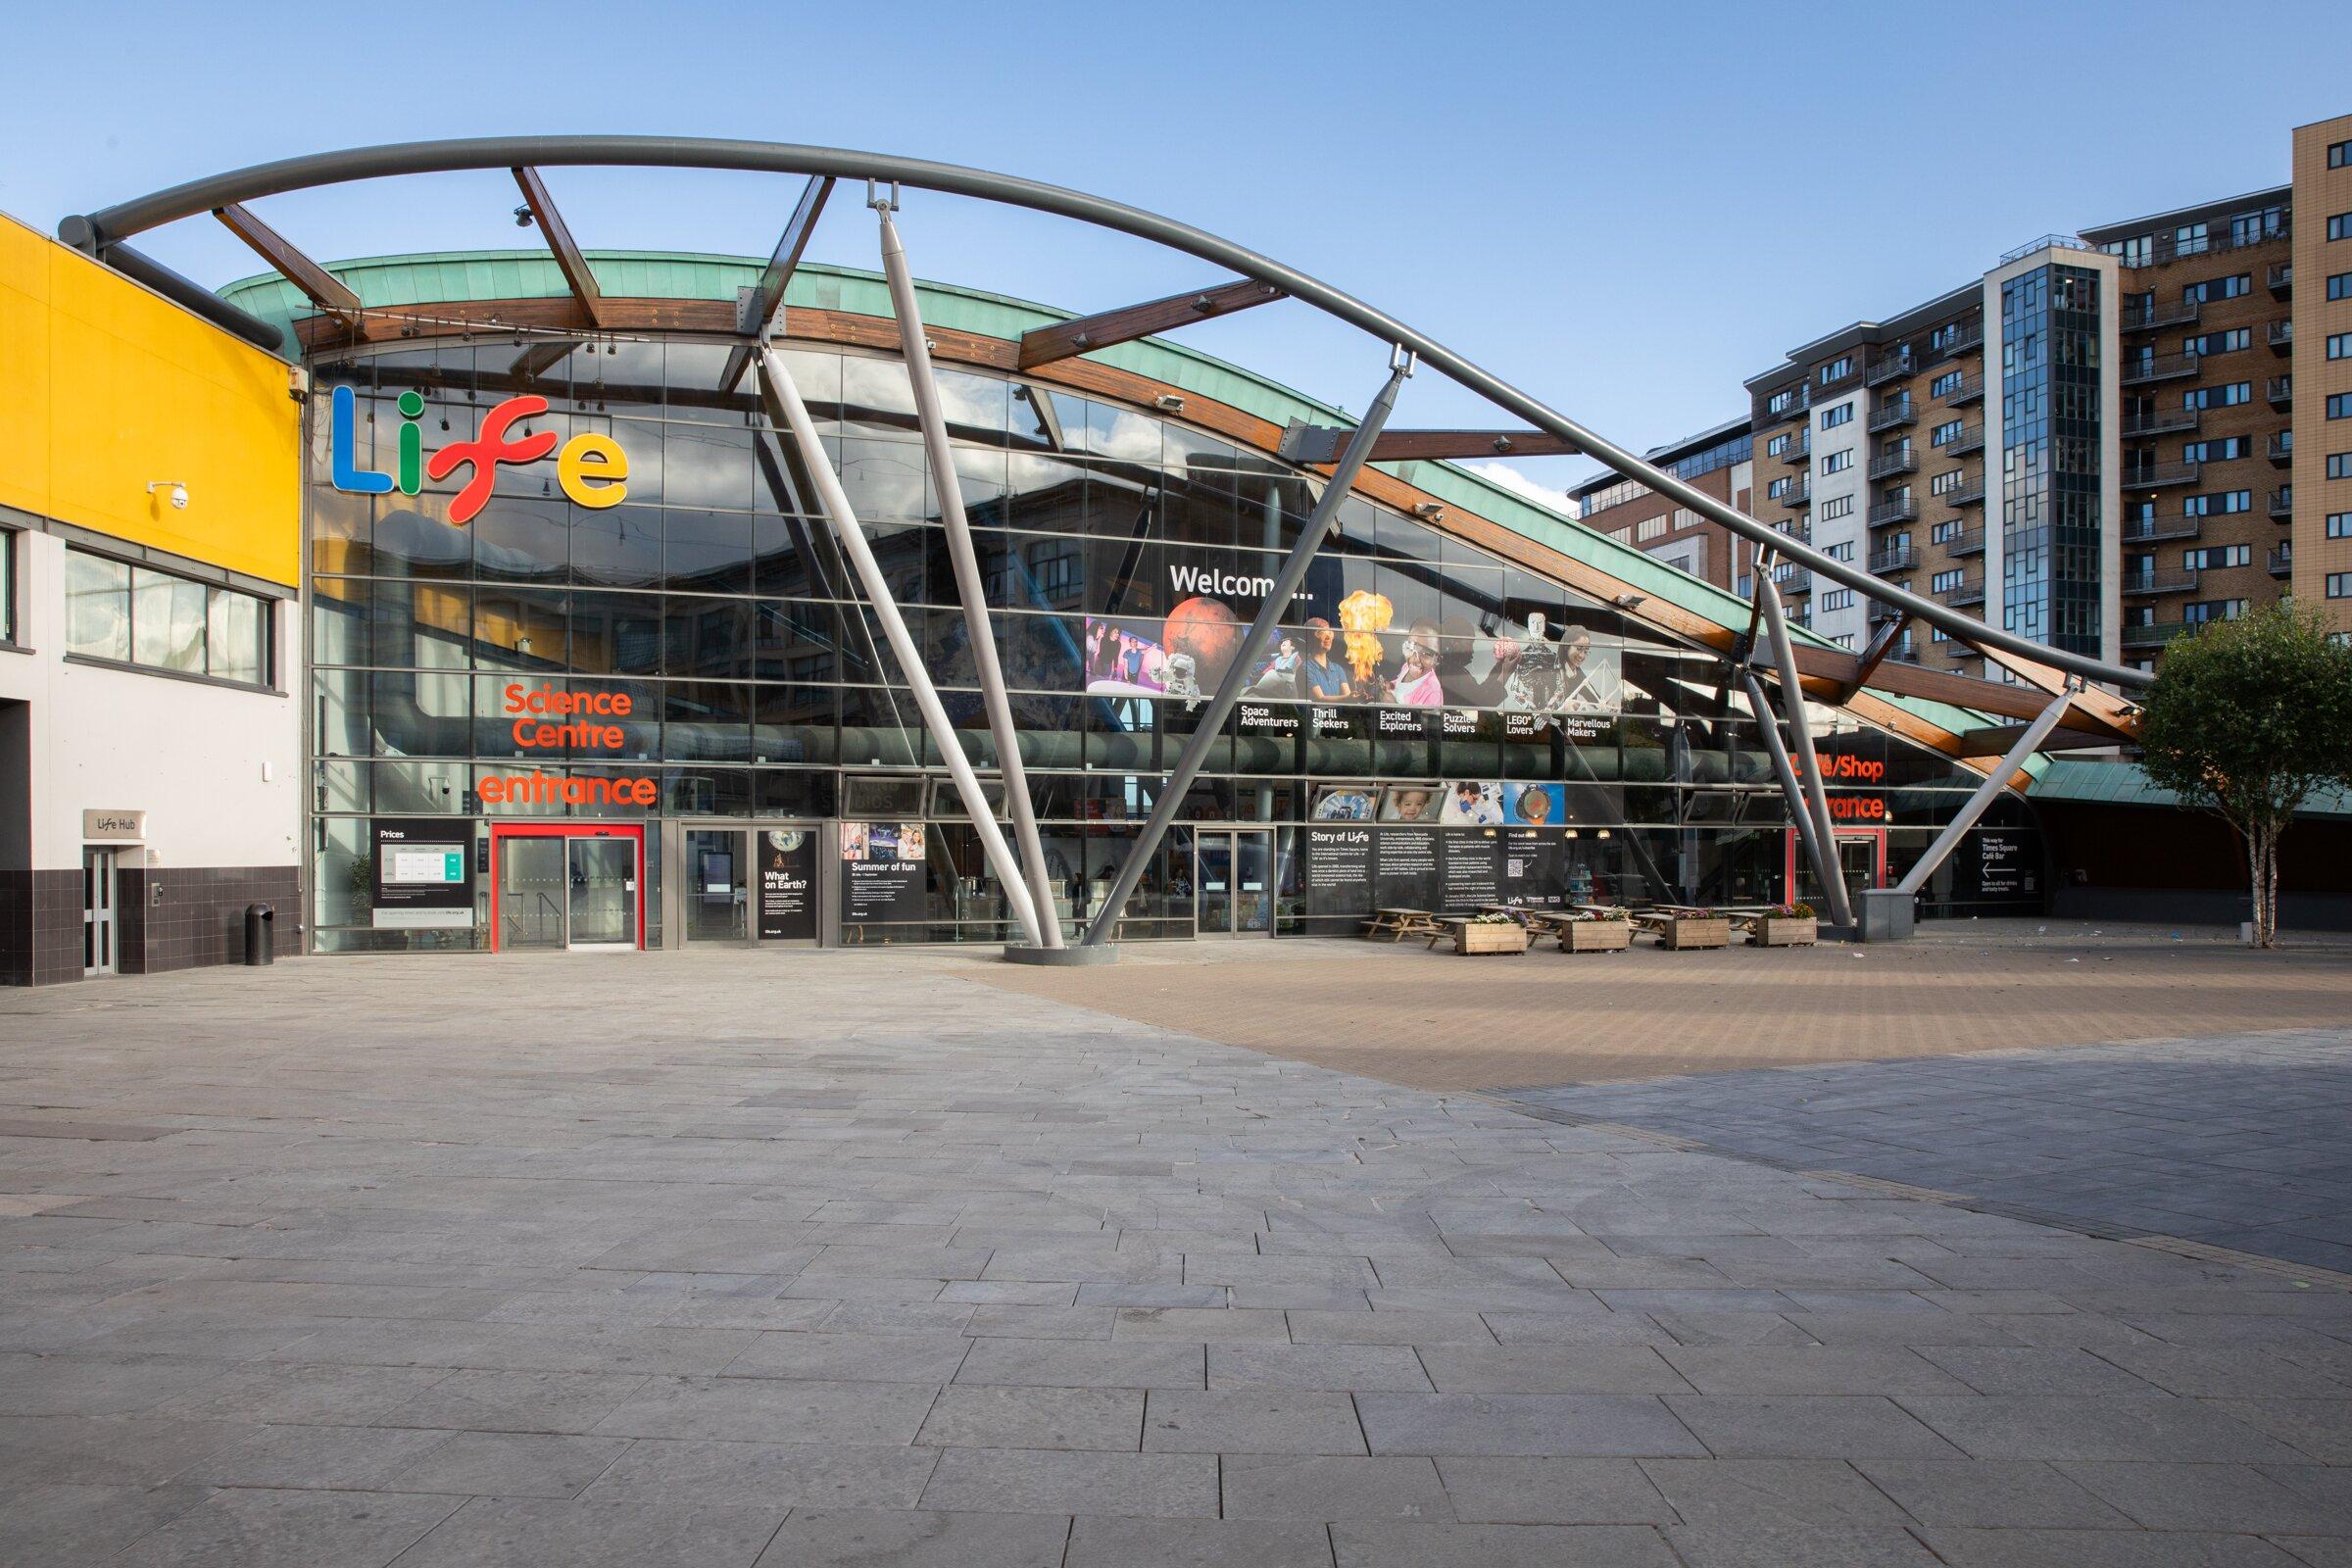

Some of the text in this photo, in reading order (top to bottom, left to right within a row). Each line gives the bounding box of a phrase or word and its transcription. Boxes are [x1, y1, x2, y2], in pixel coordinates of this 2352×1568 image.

[331, 385, 629, 525] Life
[1169, 564, 1314, 601] Welcom...
[505, 682, 632, 715] Science
[1241, 706, 1269, 717] Space
[1312, 709, 1337, 719] Thrill
[1380, 710, 1411, 721] Excited
[1241, 716, 1298, 727] Adventurers
[1444, 713, 1471, 723] Puzzle
[1567, 718, 1610, 728] Marvellous
[1312, 718, 1348, 729] Seekers
[1380, 721, 1422, 732] Explorers
[1444, 723, 1476, 733] Solvers
[513, 717, 624, 749] Centre
[1506, 725, 1534, 735] Lovers
[1568, 728, 1596, 737] Makers
[478, 770, 658, 805] entrance
[98, 818, 135, 831] Life Hub
[380, 830, 405, 839] Prices
[1311, 831, 1369, 843] Story of Life
[1999, 844, 2018, 853] Square
[852, 862, 916, 871] Summer of fun
[764, 871, 789, 881] What
[778, 880, 807, 889] Earth?
[1508, 896, 1522, 905] Life
